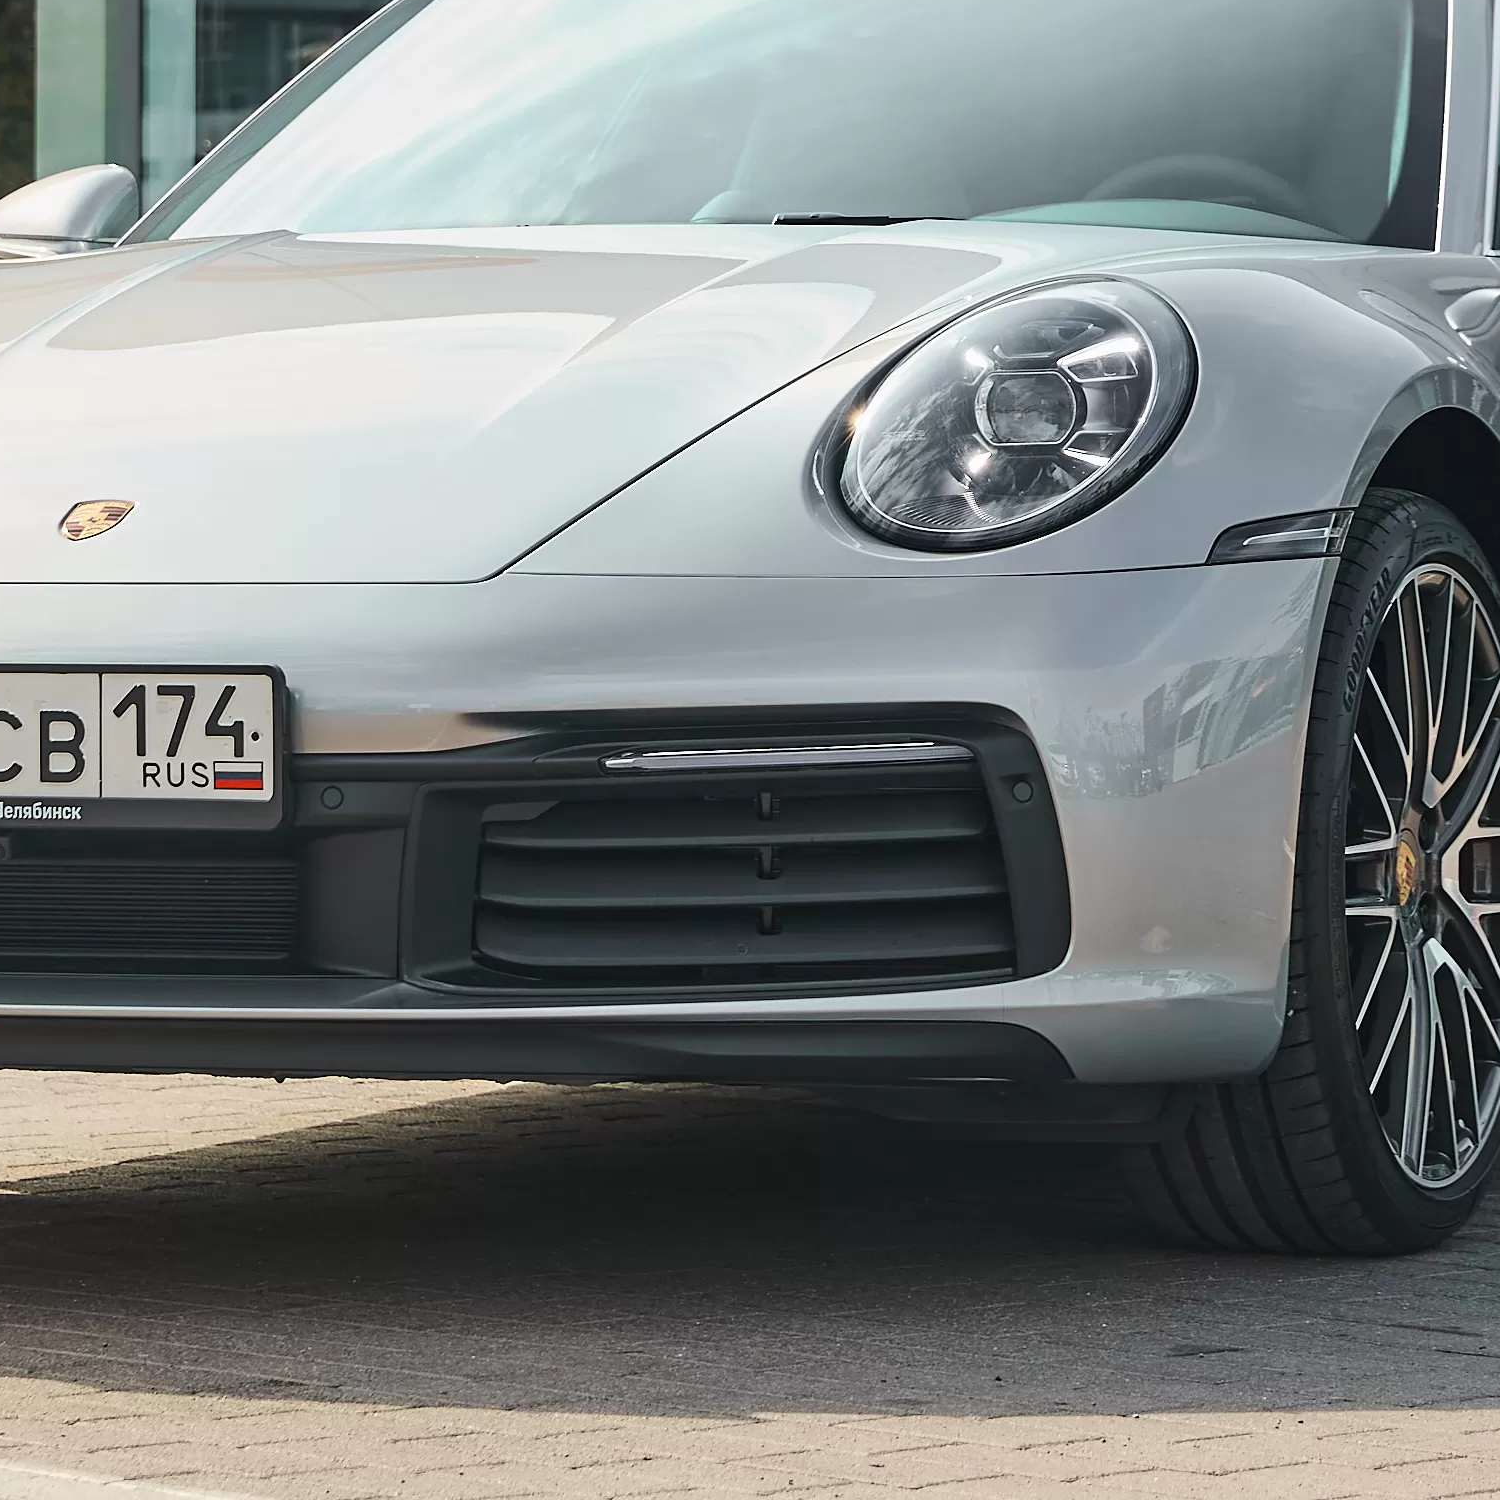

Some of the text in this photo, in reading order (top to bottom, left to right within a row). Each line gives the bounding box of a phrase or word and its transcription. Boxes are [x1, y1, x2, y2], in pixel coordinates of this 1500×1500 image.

[1343, 566, 1393, 714] GOODYEAR
[112, 684, 245, 759] 174
[142, 761, 210, 789] RUS
